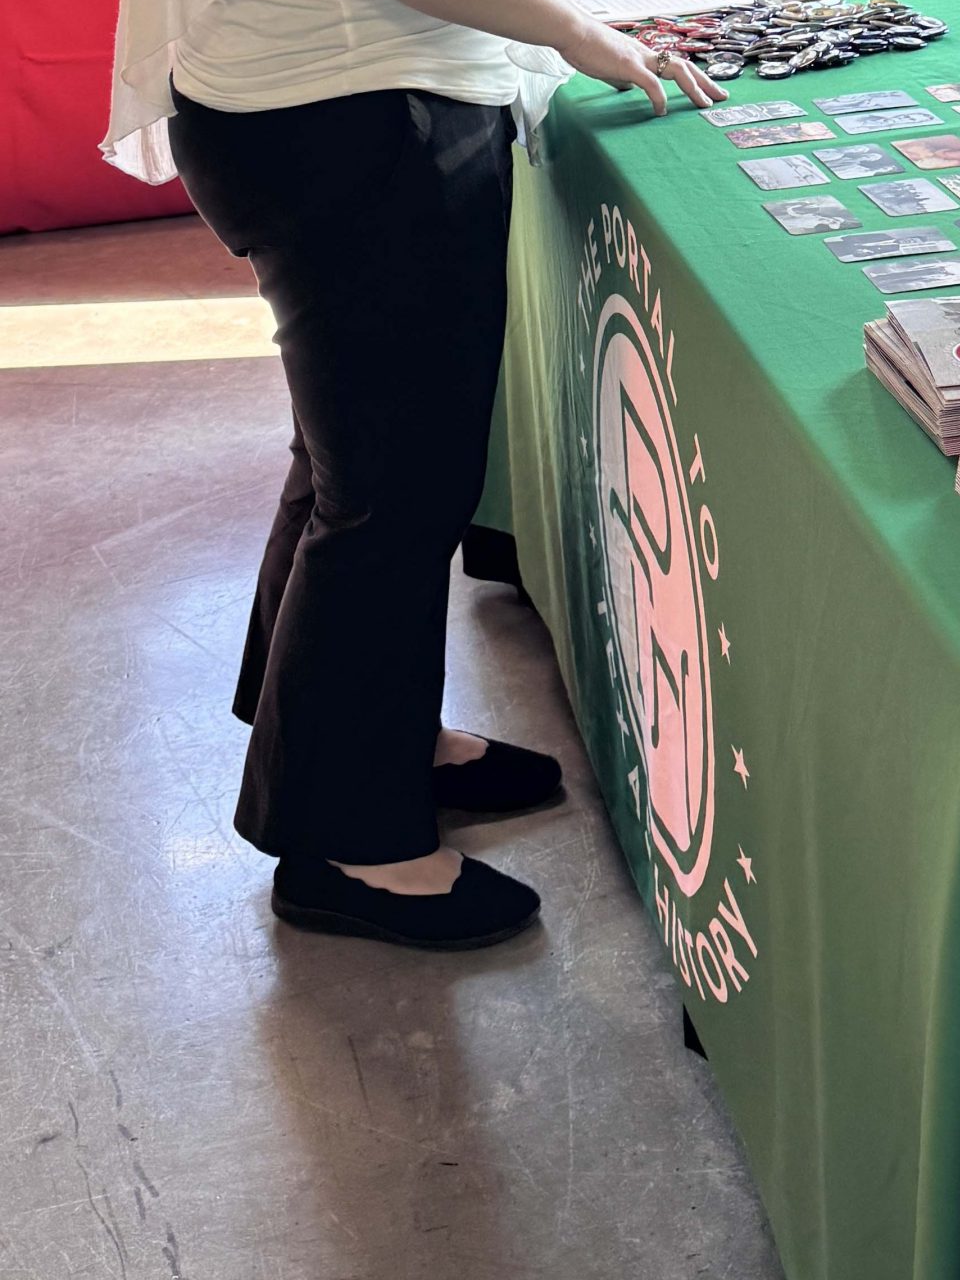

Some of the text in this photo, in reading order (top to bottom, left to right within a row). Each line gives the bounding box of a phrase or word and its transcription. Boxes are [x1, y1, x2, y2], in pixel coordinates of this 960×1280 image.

[577, 203, 719, 581] THE PORTAL TO
[654, 862, 758, 1004] HISTORY
